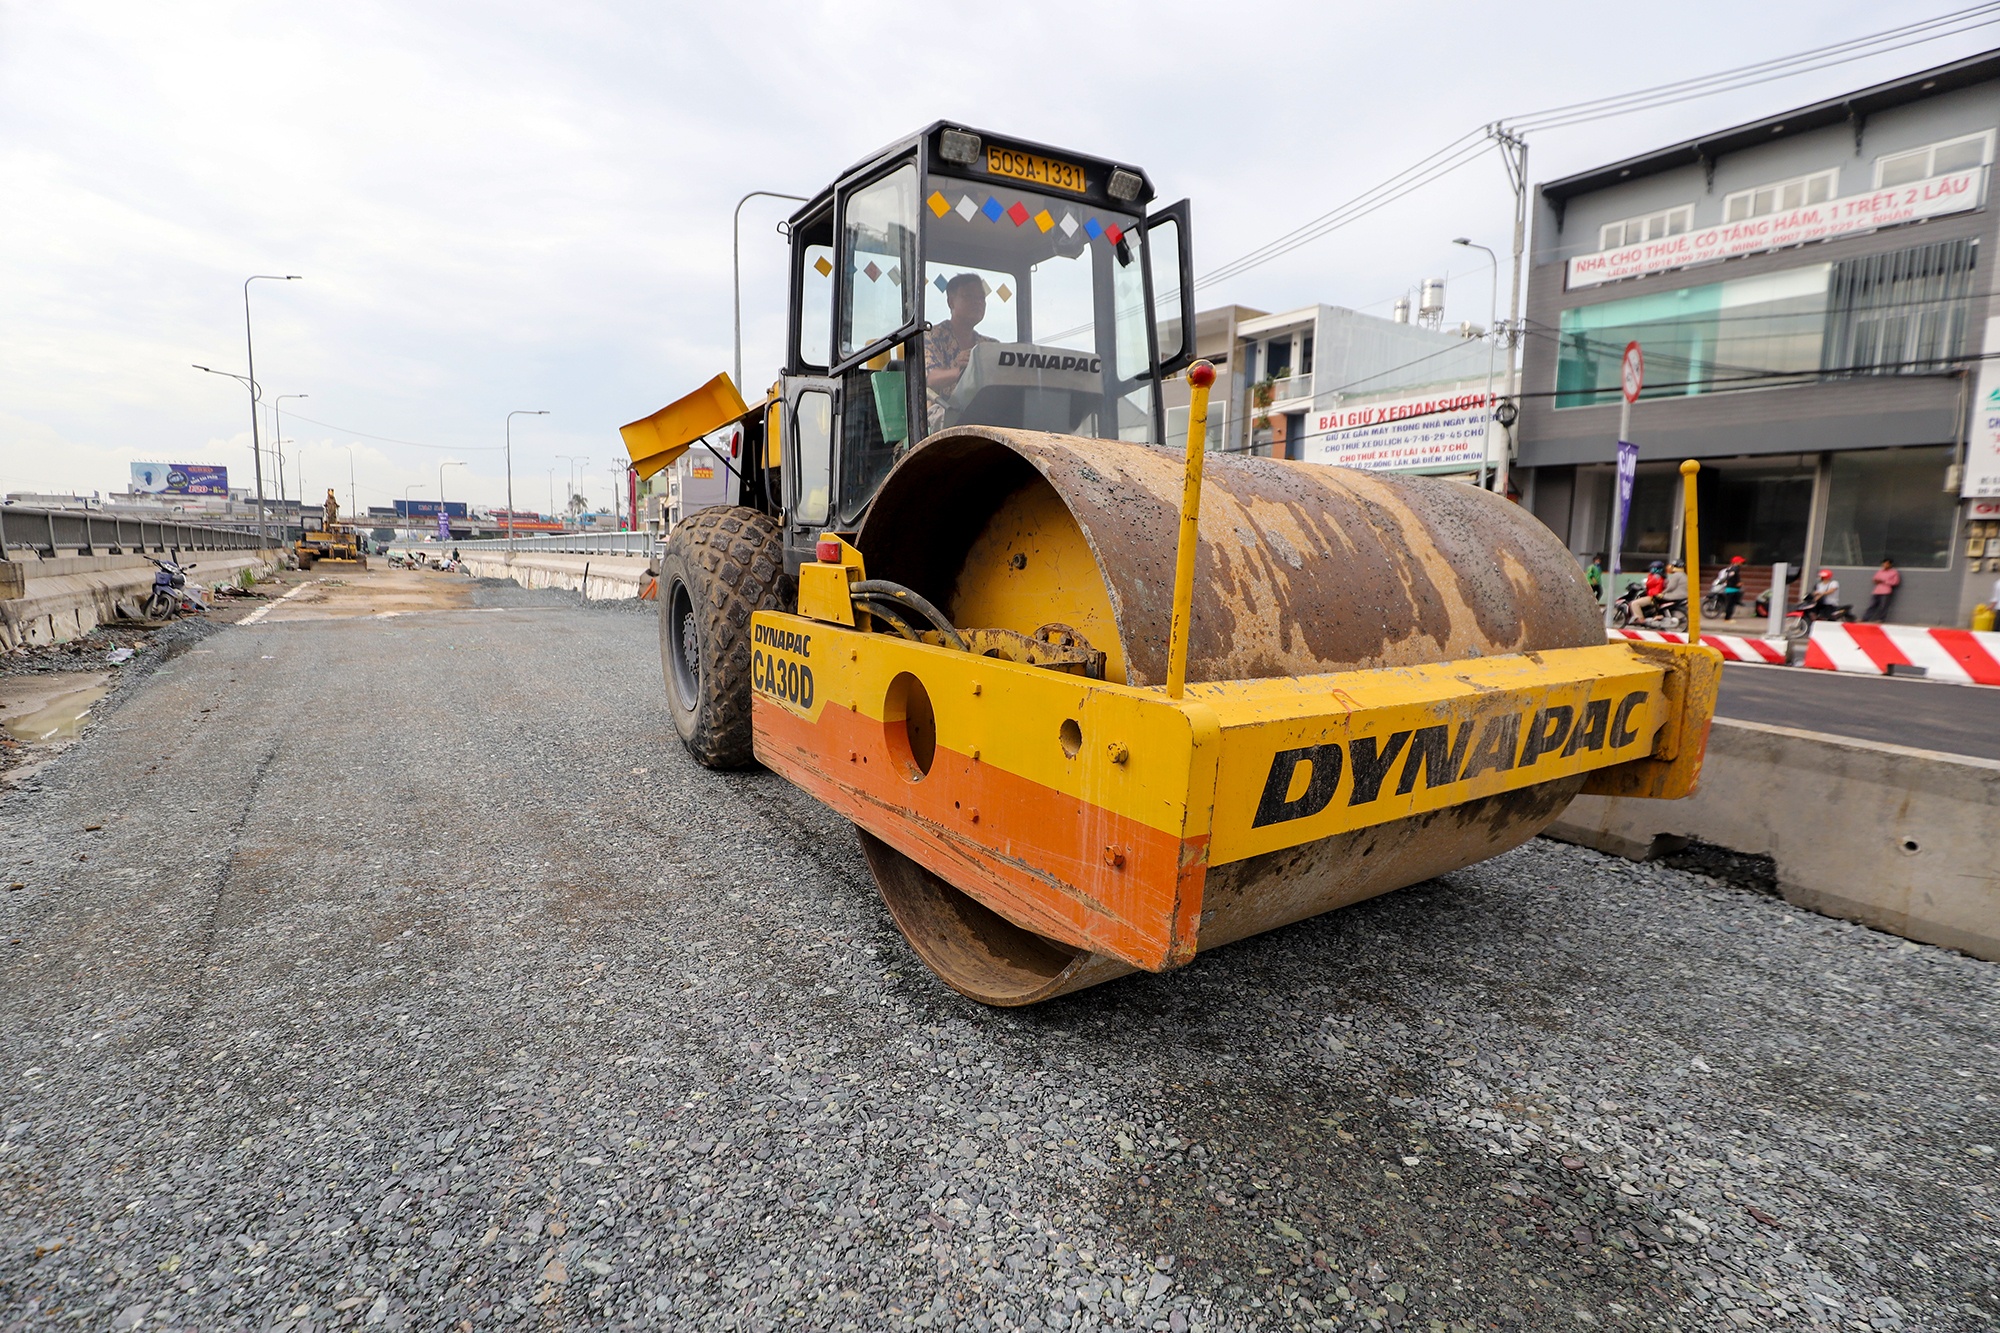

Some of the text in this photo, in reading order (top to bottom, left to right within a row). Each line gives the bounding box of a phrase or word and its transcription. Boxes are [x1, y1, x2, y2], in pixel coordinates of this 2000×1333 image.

[989, 148, 1081, 189] 50SA-1331
[1576, 255, 1606, 273] NHÀ
[1609, 249, 1642, 266] CHO
[1695, 231, 1718, 248] CÓ
[1904, 188, 1918, 205] 2
[998, 351, 1101, 373] DYNAPAC
[1392, 422, 1421, 433] TRONG
[754, 624, 811, 658] DYNAPAC
[753, 650, 814, 709] CA30D
[1251, 690, 1649, 829] DYNAPAC
